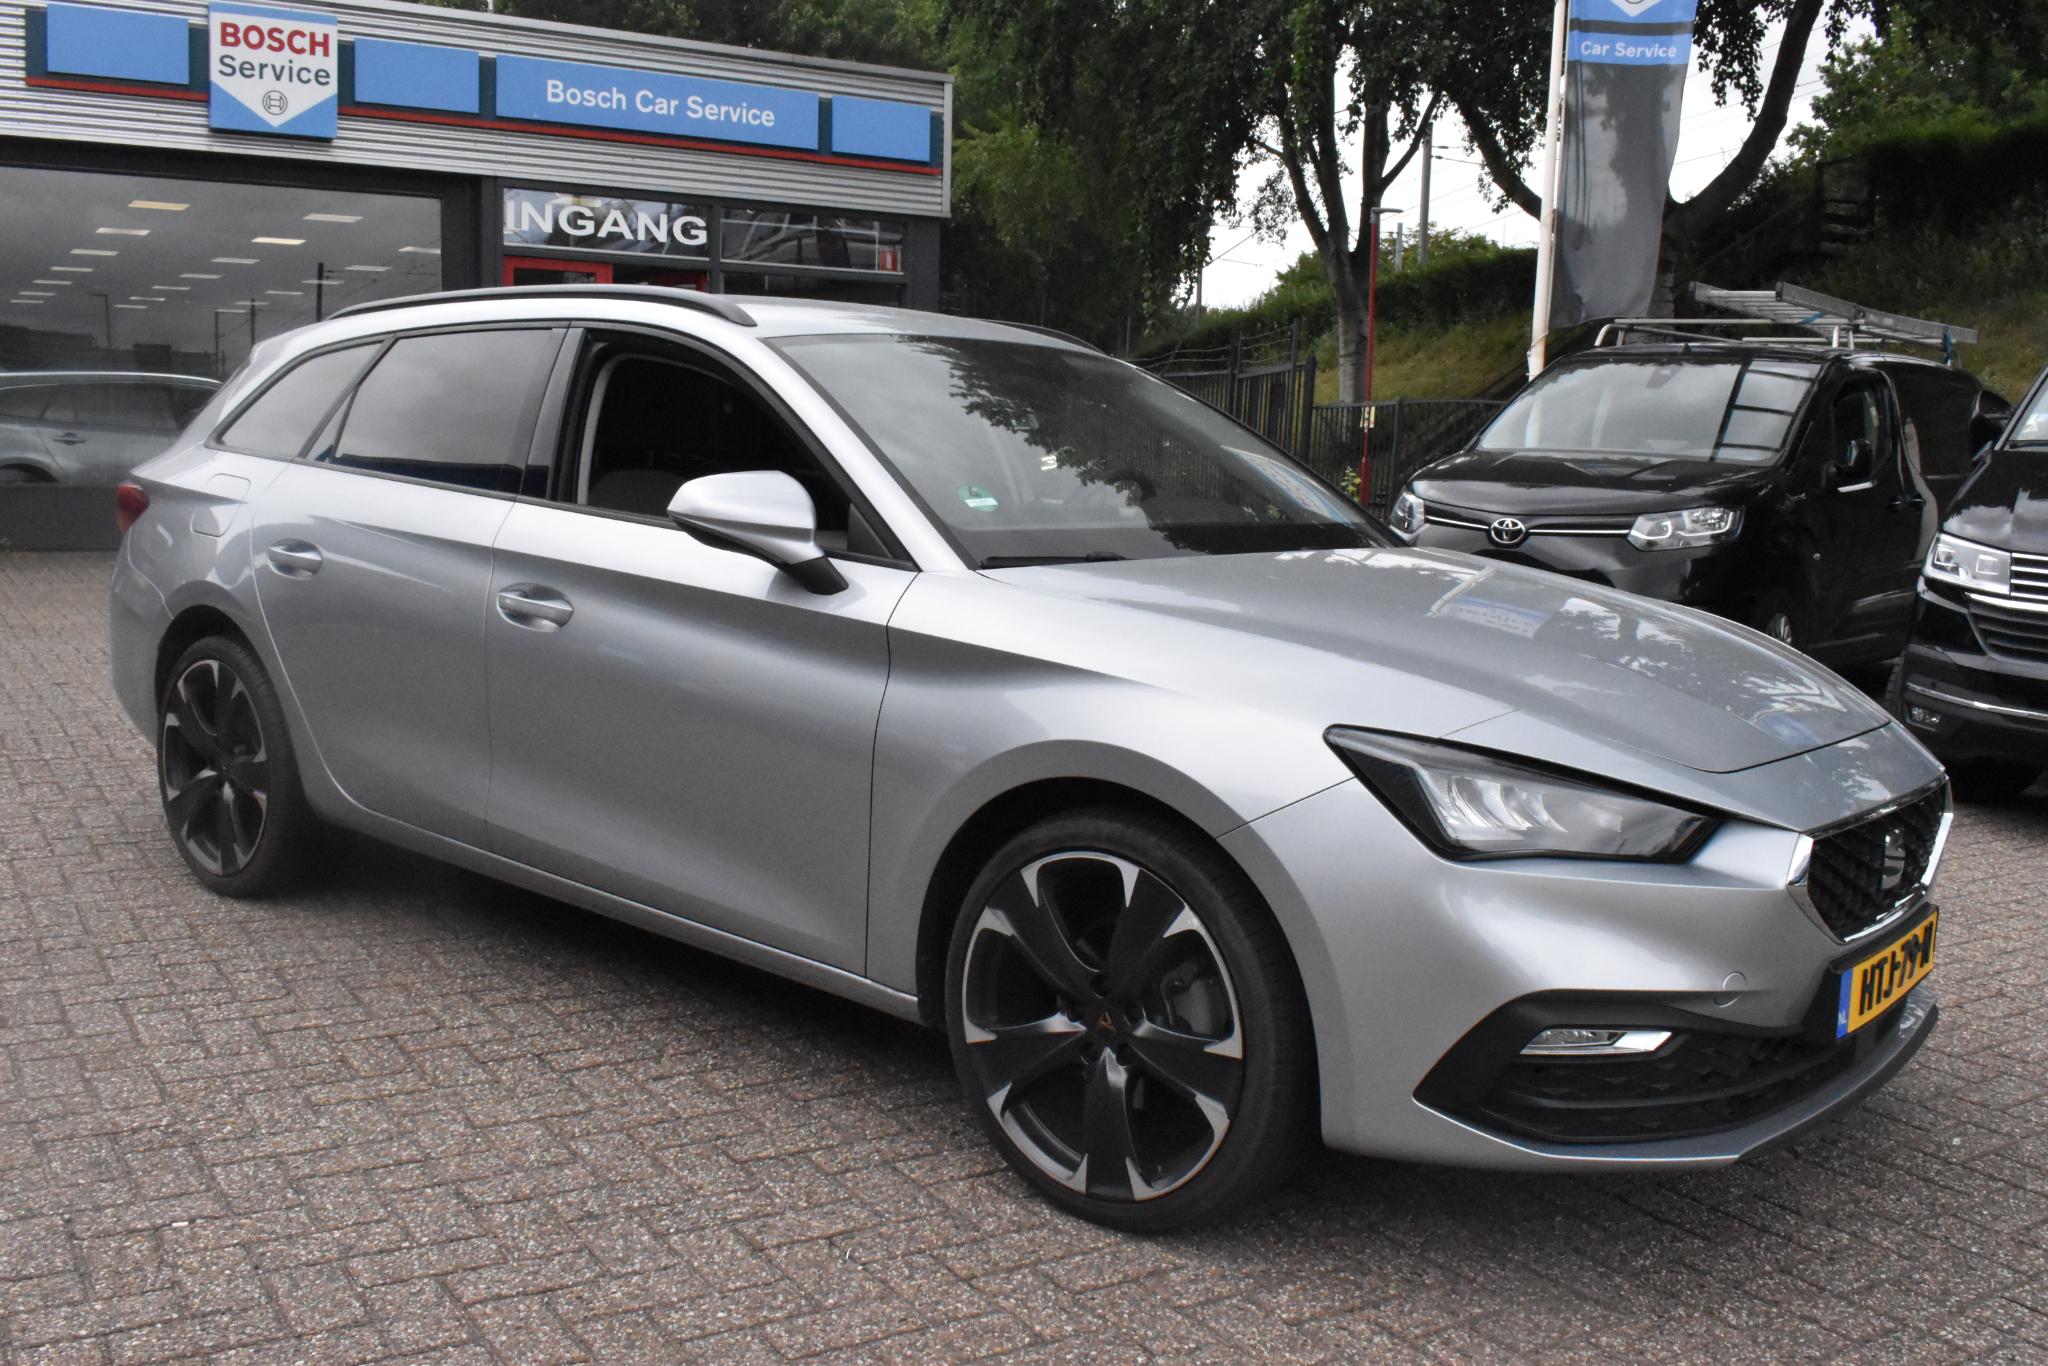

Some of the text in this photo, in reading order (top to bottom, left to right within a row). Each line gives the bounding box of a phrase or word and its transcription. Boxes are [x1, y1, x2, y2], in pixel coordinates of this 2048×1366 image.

[220, 21, 330, 58] BOSCH
[1580, 40, 1678, 58] Car Service
[218, 54, 331, 86] Service
[546, 79, 775, 127] Bosch Car Service
[505, 200, 708, 246] INGANG
